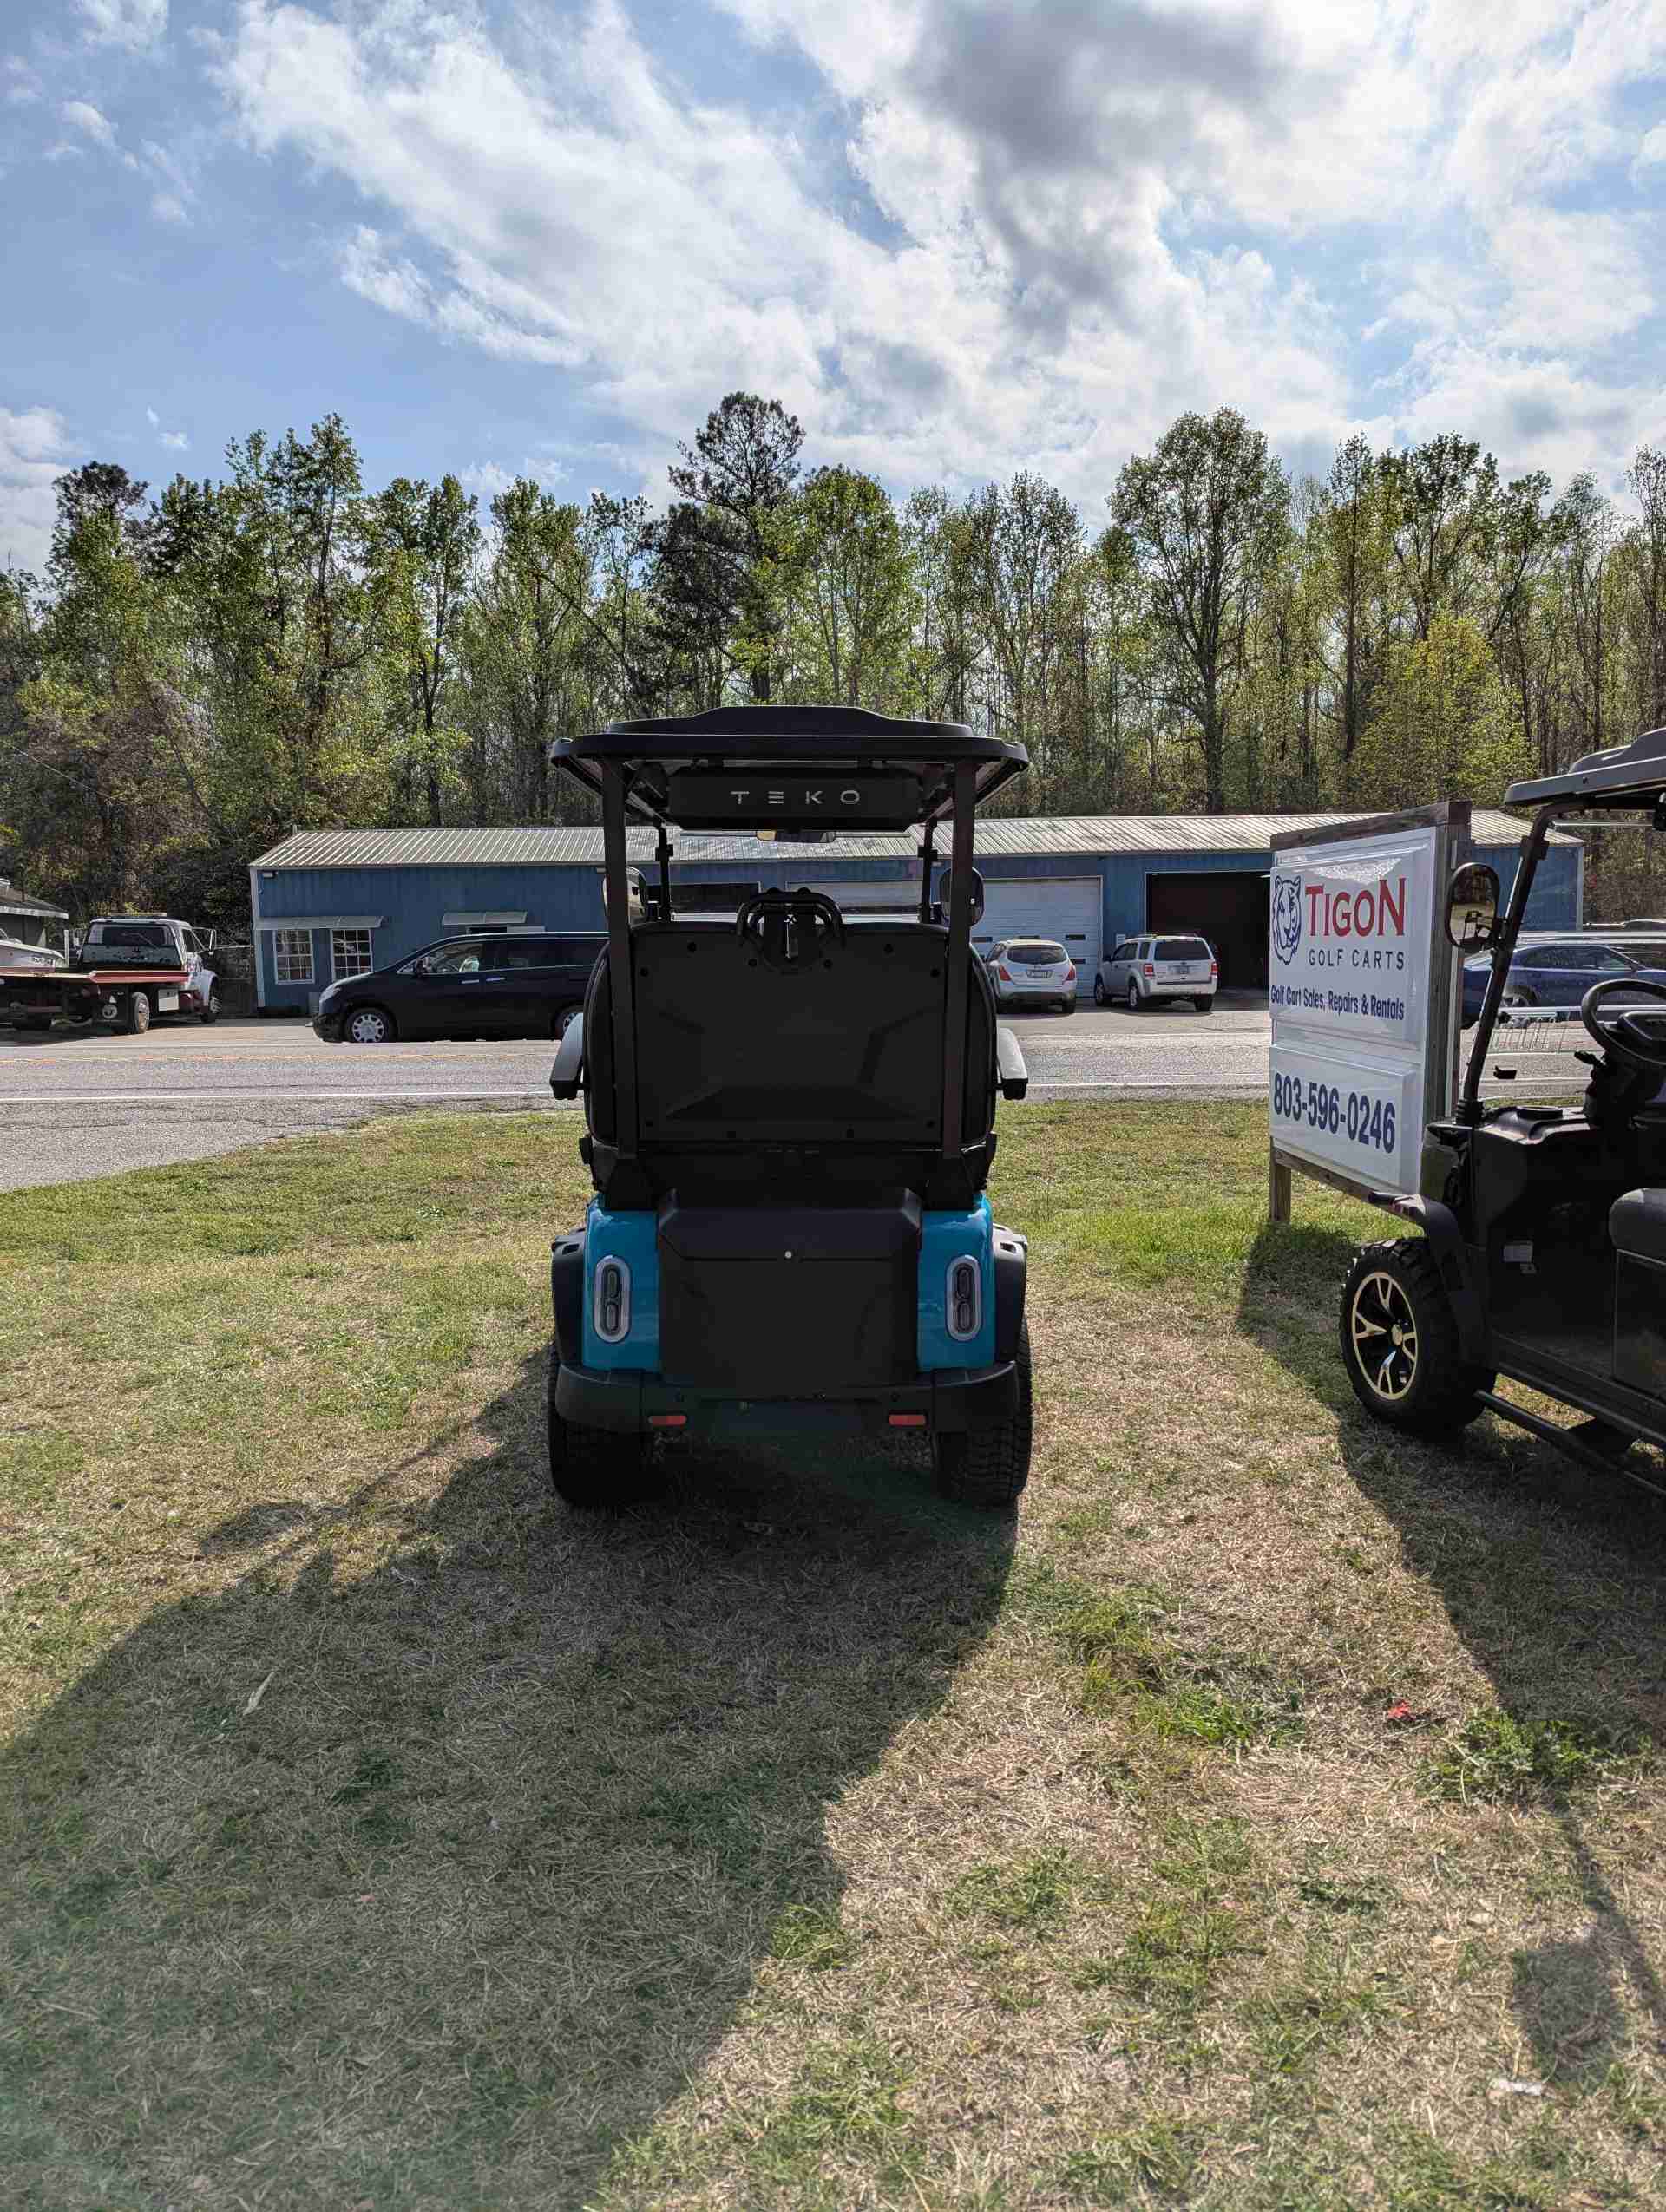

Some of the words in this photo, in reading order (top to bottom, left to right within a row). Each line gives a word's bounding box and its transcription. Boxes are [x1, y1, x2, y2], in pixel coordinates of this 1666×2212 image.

[730, 789, 861, 805] TEKO
[1309, 949, 1344, 966] GOLF
[1353, 950, 1404, 970] CARTS
[1271, 985, 1285, 1005] Golf
[1286, 987, 1301, 1006] Cart
[1303, 989, 1325, 1011] Sales,
[1328, 991, 1359, 1015] Repairs
[1361, 995, 1368, 1015] &
[1370, 995, 1404, 1021] Rentals
[1274, 1072, 1395, 1154] 803-596-0246
